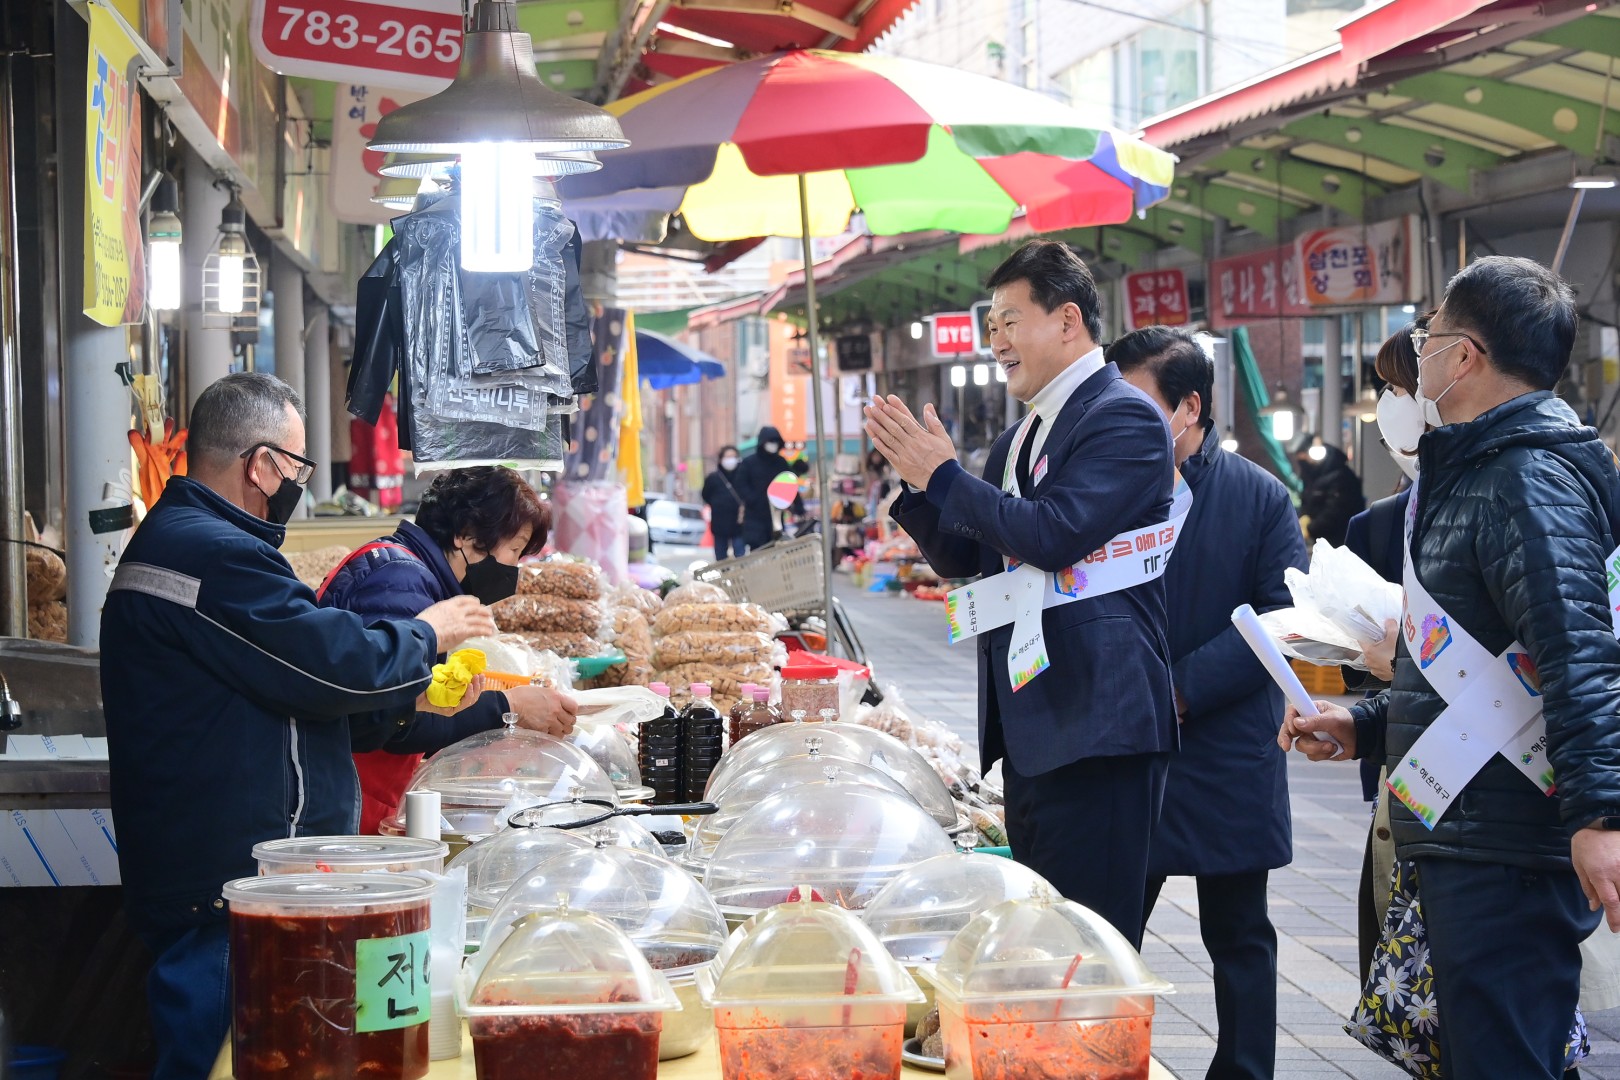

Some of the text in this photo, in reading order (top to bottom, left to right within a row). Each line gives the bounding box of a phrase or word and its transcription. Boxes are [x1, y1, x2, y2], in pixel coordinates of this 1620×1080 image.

[278, 5, 461, 63] 783-265
[1134, 290, 1183, 315] 과일
[937, 325, 972, 344] BYC
